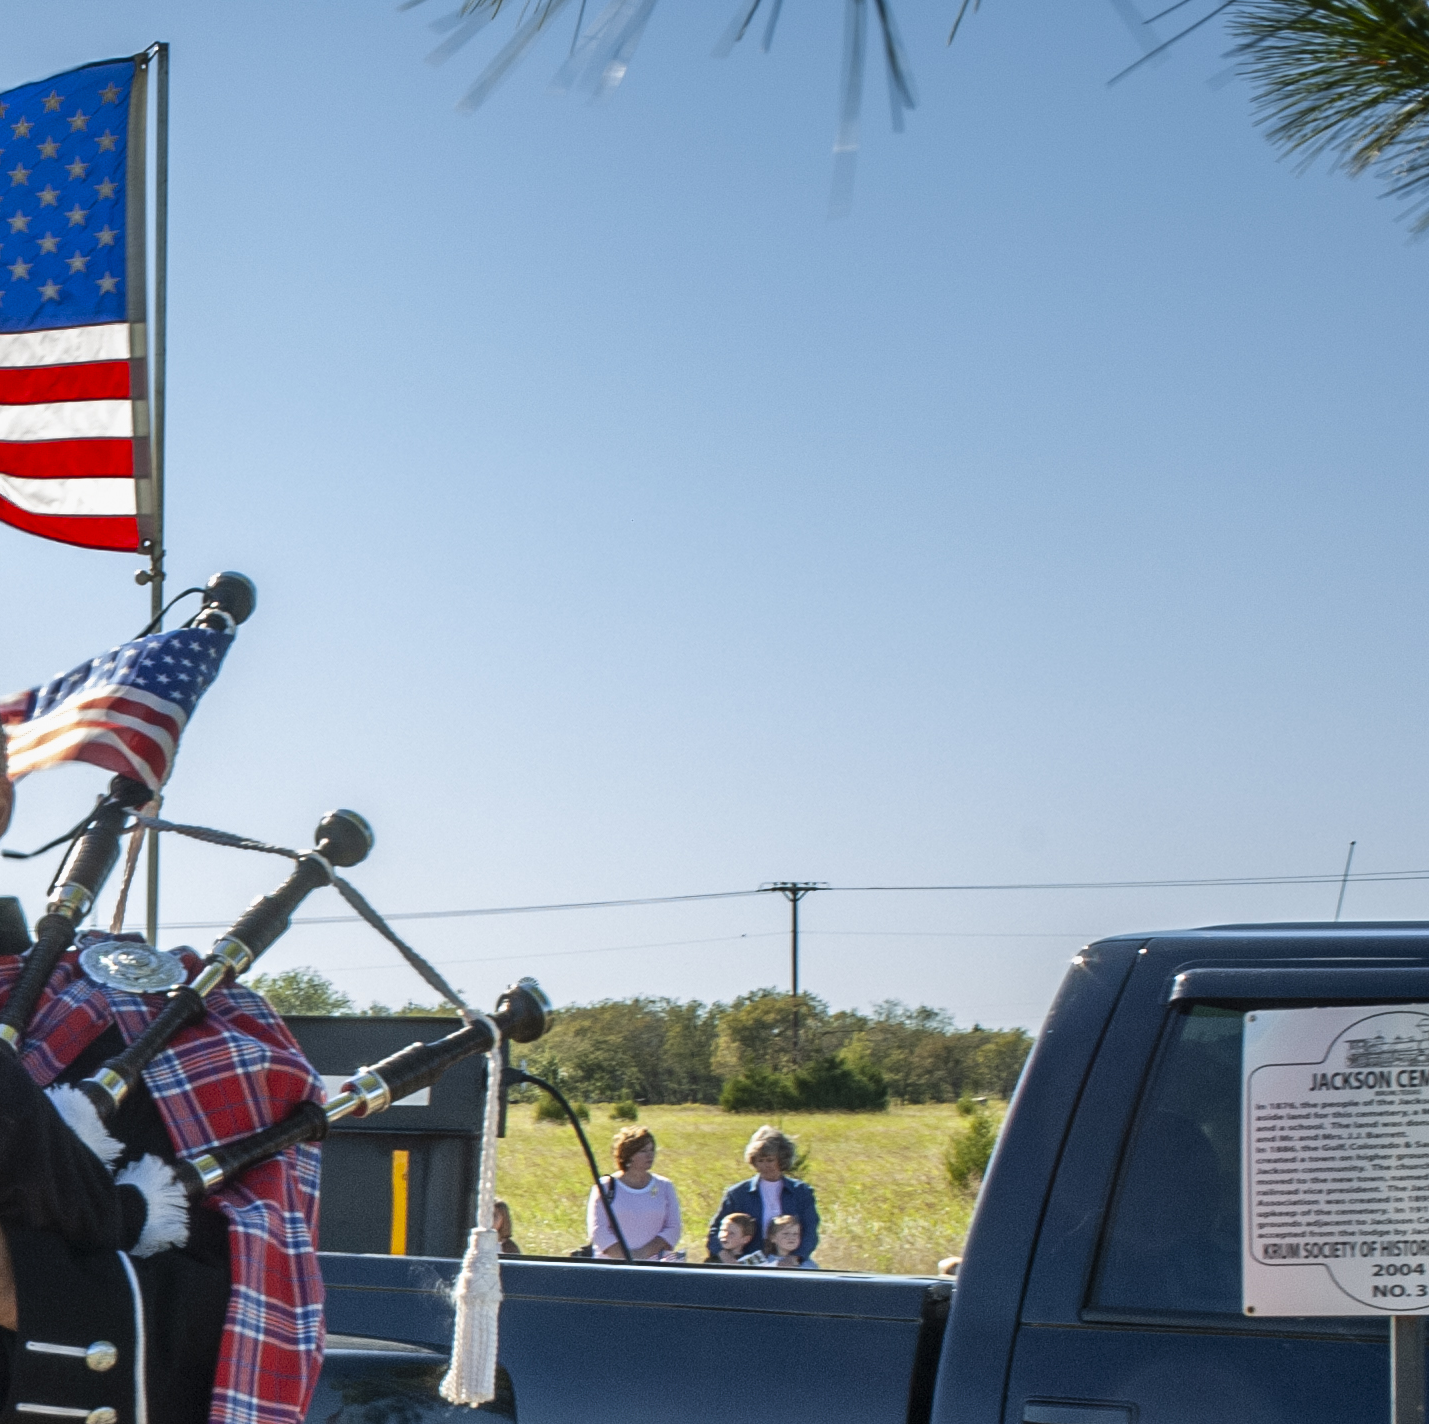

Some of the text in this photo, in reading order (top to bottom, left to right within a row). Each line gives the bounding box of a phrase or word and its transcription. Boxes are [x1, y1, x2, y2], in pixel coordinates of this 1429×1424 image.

[1309, 1070, 1392, 1091] JACKSON
[1263, 1243, 1300, 1260] KRUM
[1303, 1242, 1357, 1259] SOCIETY
[1360, 1241, 1377, 1257] OF
[1372, 1263, 1426, 1277] 2004
[1372, 1284, 1411, 1298] NO.
